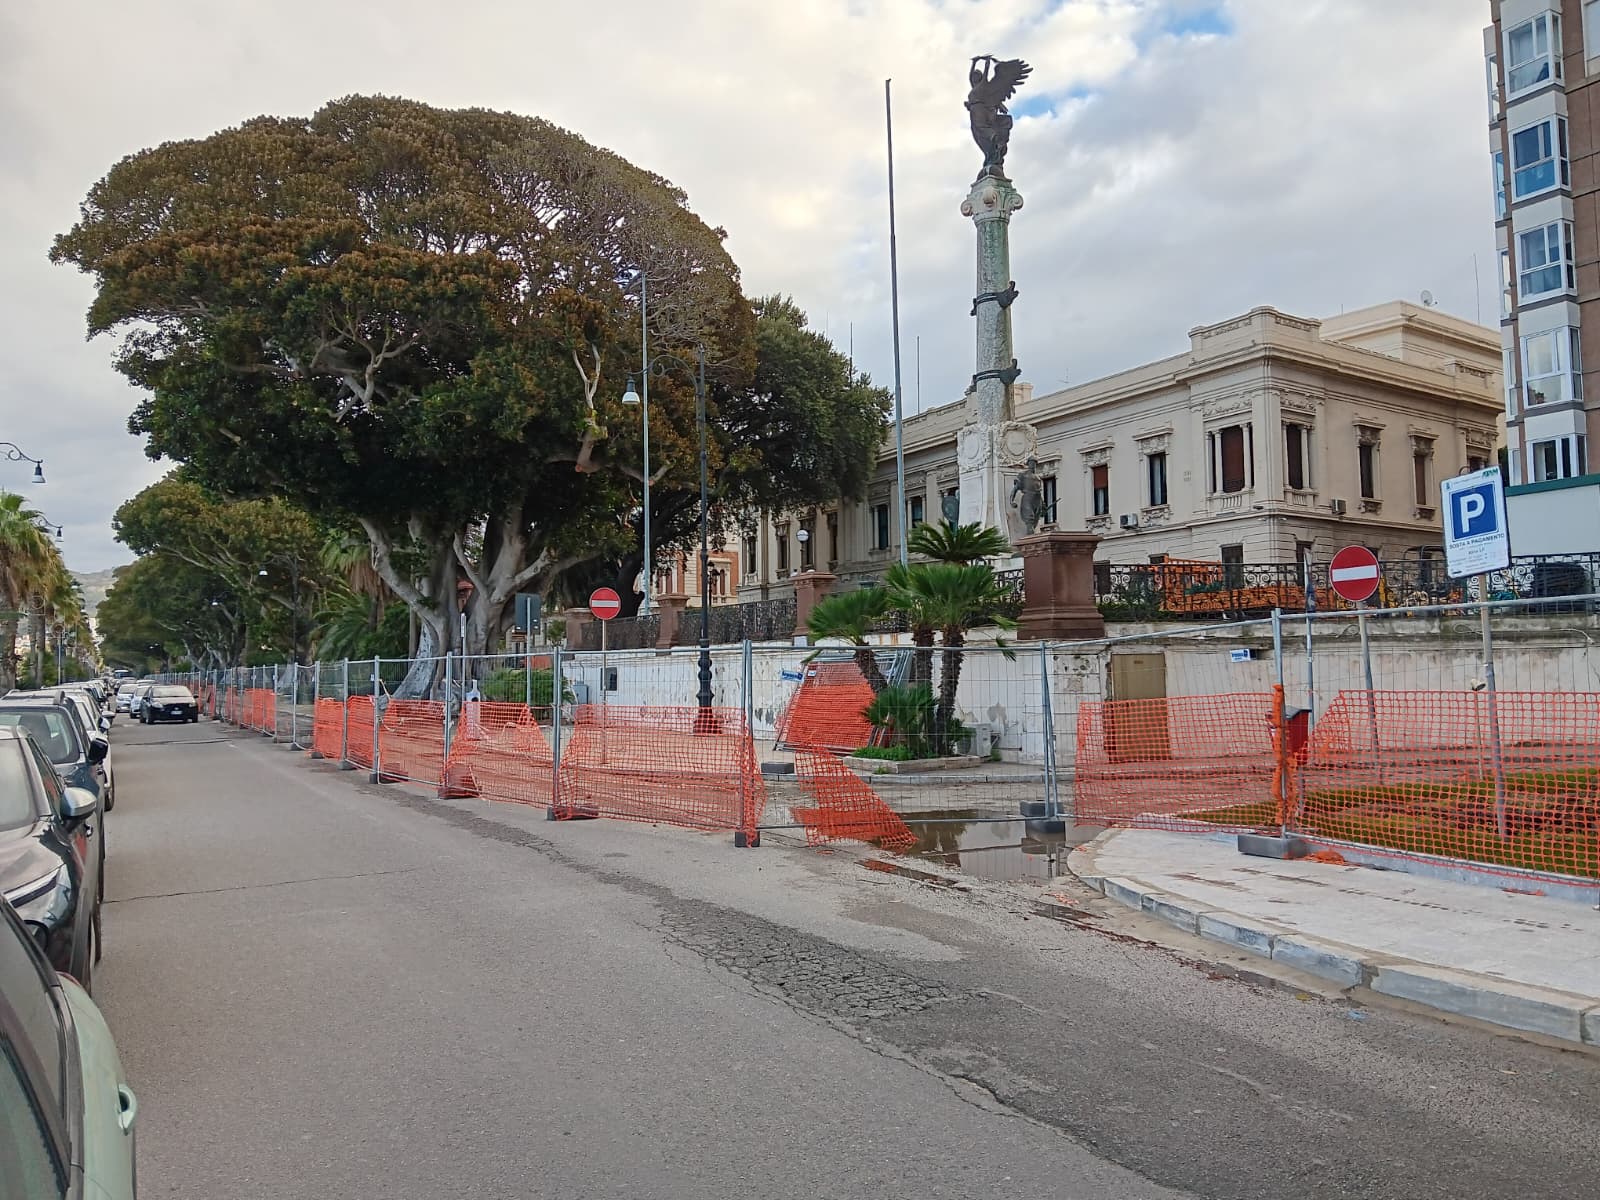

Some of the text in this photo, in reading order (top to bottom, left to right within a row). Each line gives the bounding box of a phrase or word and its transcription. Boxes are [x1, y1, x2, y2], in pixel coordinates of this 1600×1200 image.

[1460, 493, 1485, 534] P
[1449, 541, 1466, 550] SOSTA
[1471, 533, 1505, 544] PAGAMENTO
